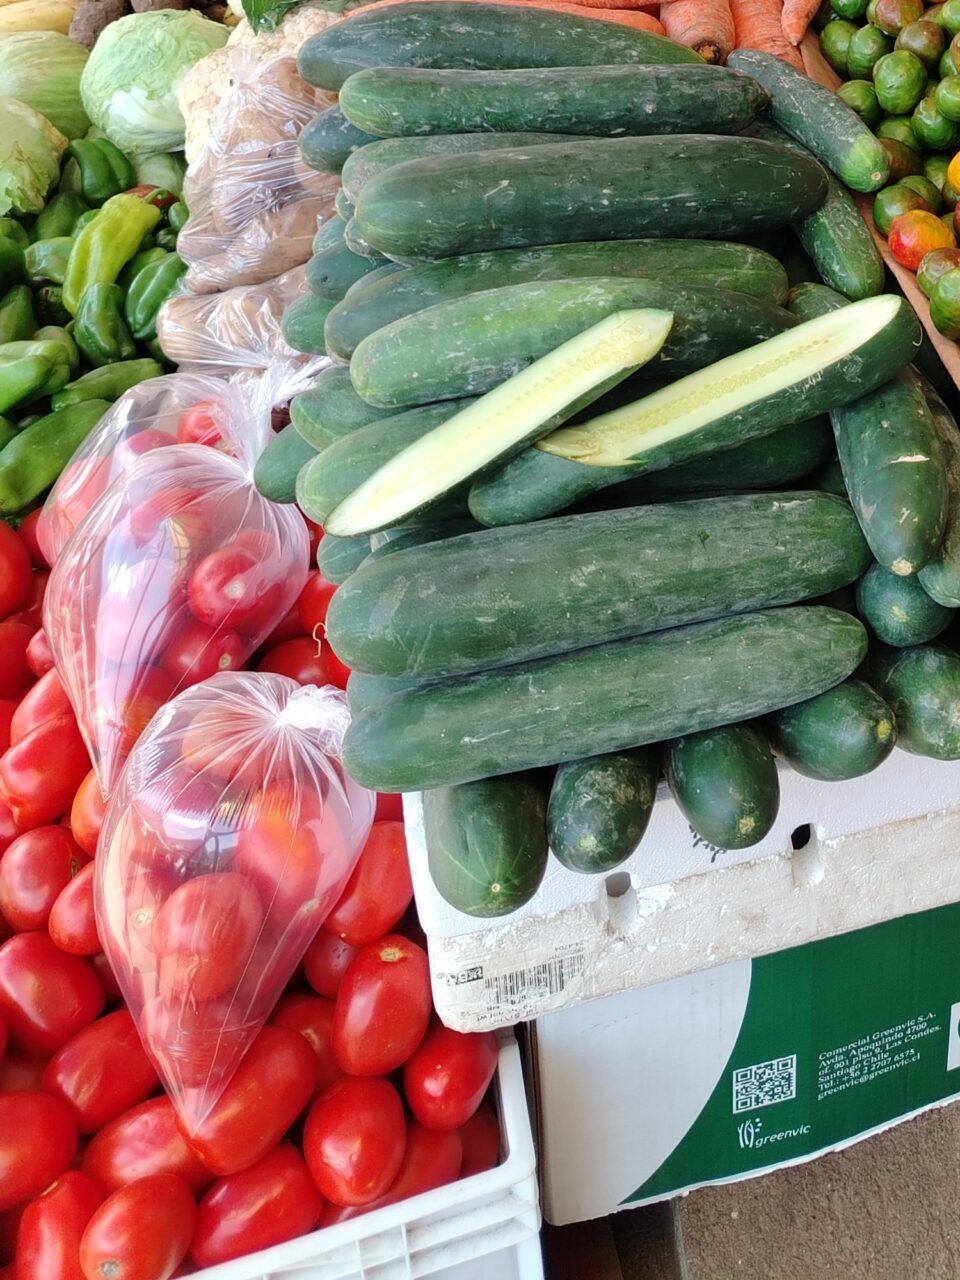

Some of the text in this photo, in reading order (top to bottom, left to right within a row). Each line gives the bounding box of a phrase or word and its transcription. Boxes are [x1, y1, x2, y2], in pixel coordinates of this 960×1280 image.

[818, 1012, 937, 1061] Comercial Greenvic S.A.
[818, 1021, 928, 1069] Avda. Apoquindo 4700
[818, 1051, 890, 1084] Santiago Chile
[833, 1059, 850, 1070] 901
[852, 1052, 873, 1065] piso
[885, 1040, 902, 1051] Las
[862, 1066, 869, 1074] 2
[870, 1057, 892, 1071] 2707
[755, 1124, 812, 1149] greenvic
